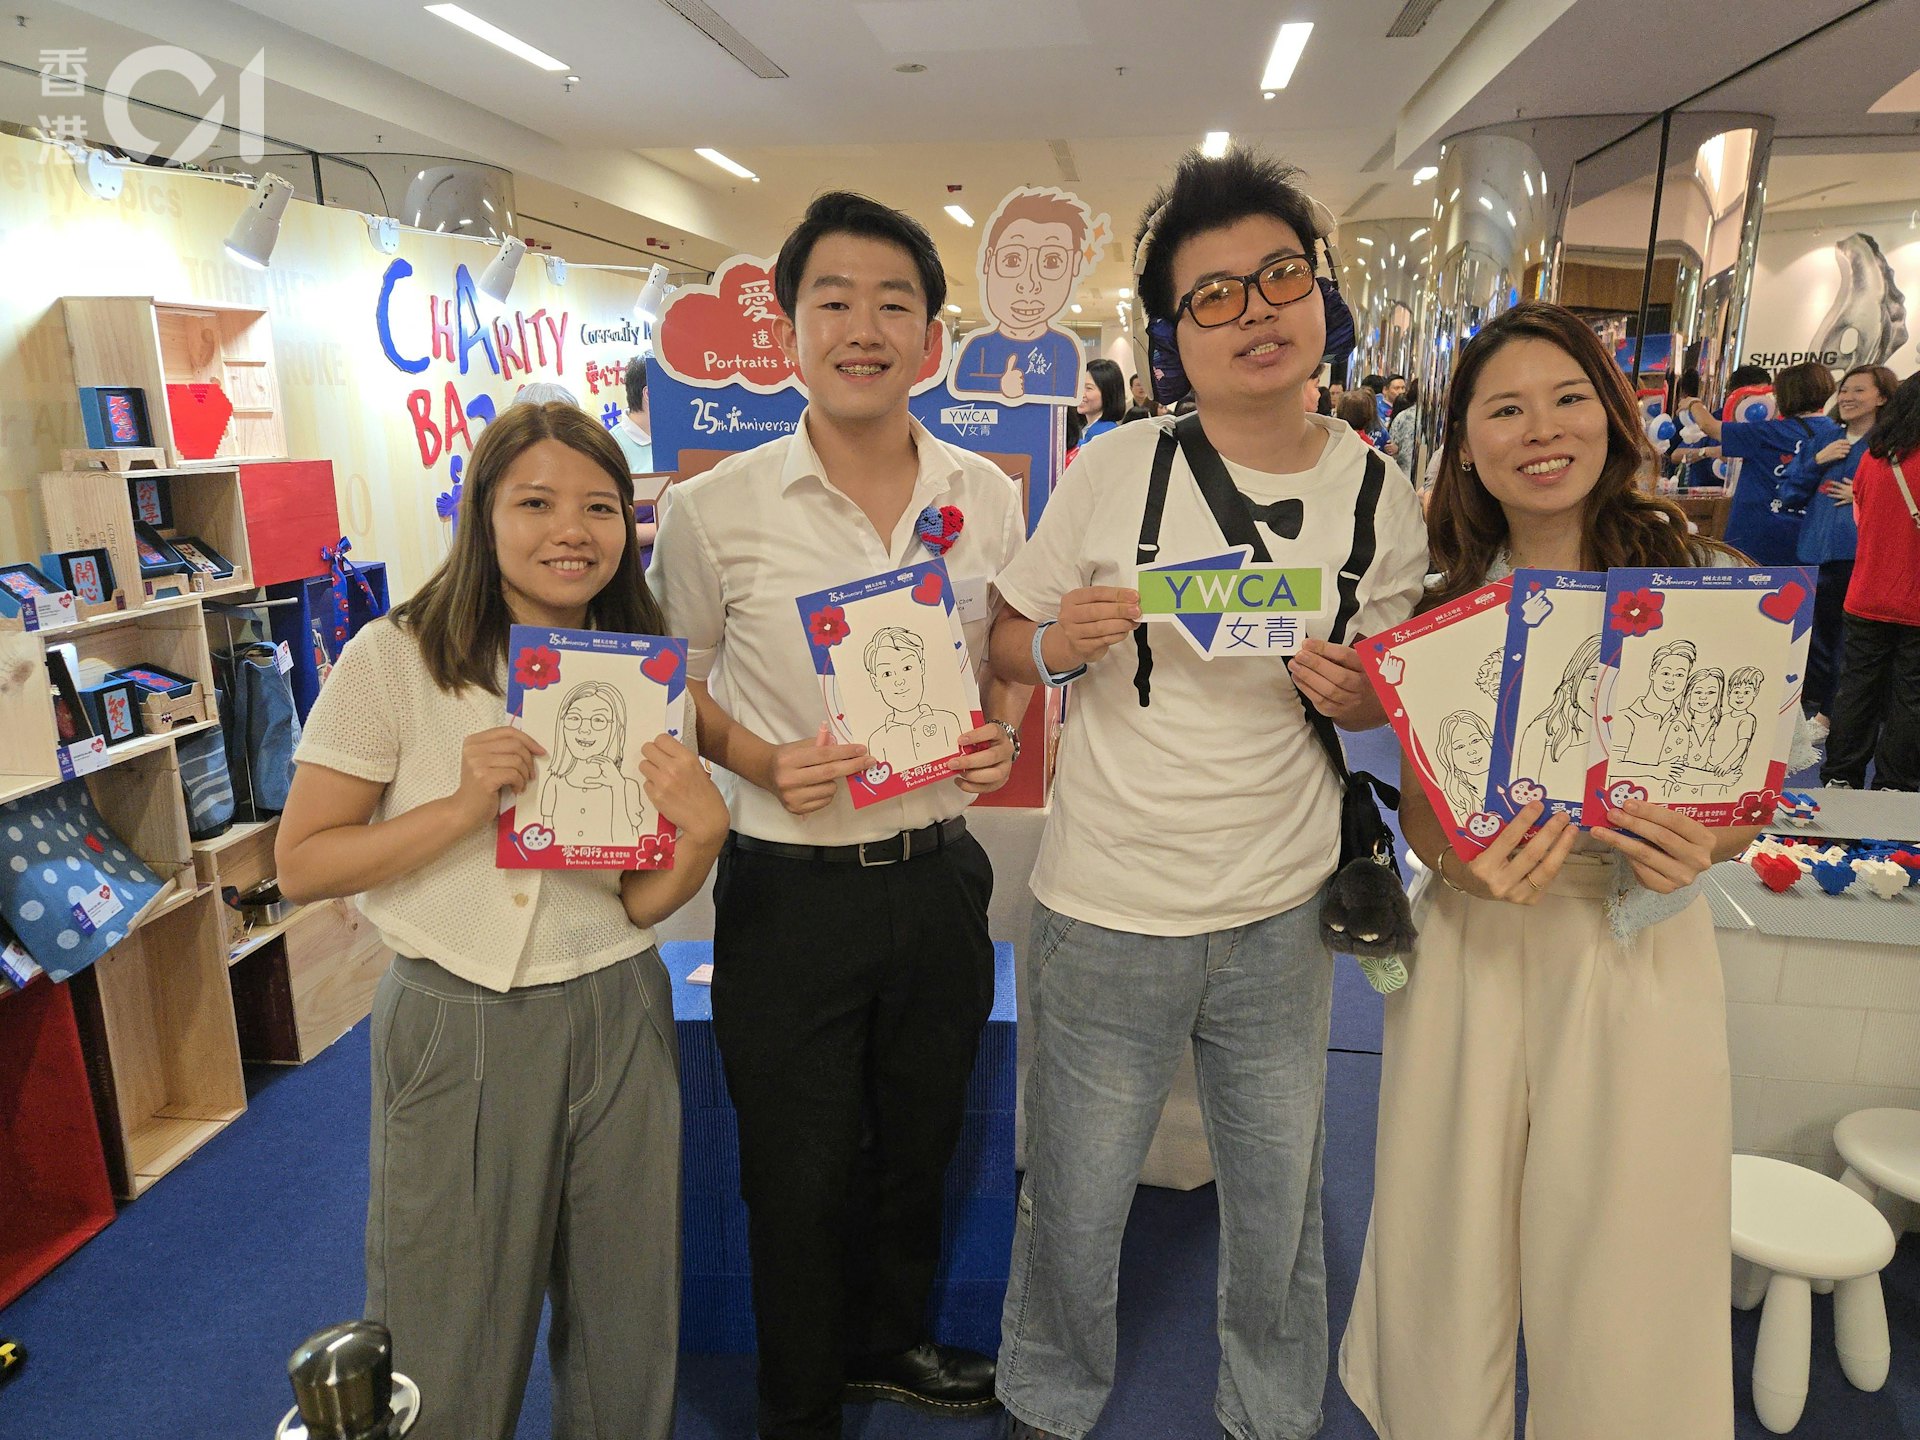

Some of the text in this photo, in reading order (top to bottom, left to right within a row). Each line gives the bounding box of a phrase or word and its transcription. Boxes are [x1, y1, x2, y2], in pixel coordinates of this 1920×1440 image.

[738, 280, 777, 322] 愛
[376, 257, 568, 381] CHARITY
[581, 317, 640, 345] Community
[703, 351, 778, 371] Portraits
[1750, 351, 1838, 366] SHAPING
[690, 398, 798, 434] 25th Anniversar
[949, 411, 991, 423] YWCA
[968, 425, 991, 436] 女青
[75, 560, 98, 601] 開心
[1165, 574, 1298, 609] YWCA
[1226, 616, 1299, 649] 女青
[565, 858, 590, 866] Portraits
